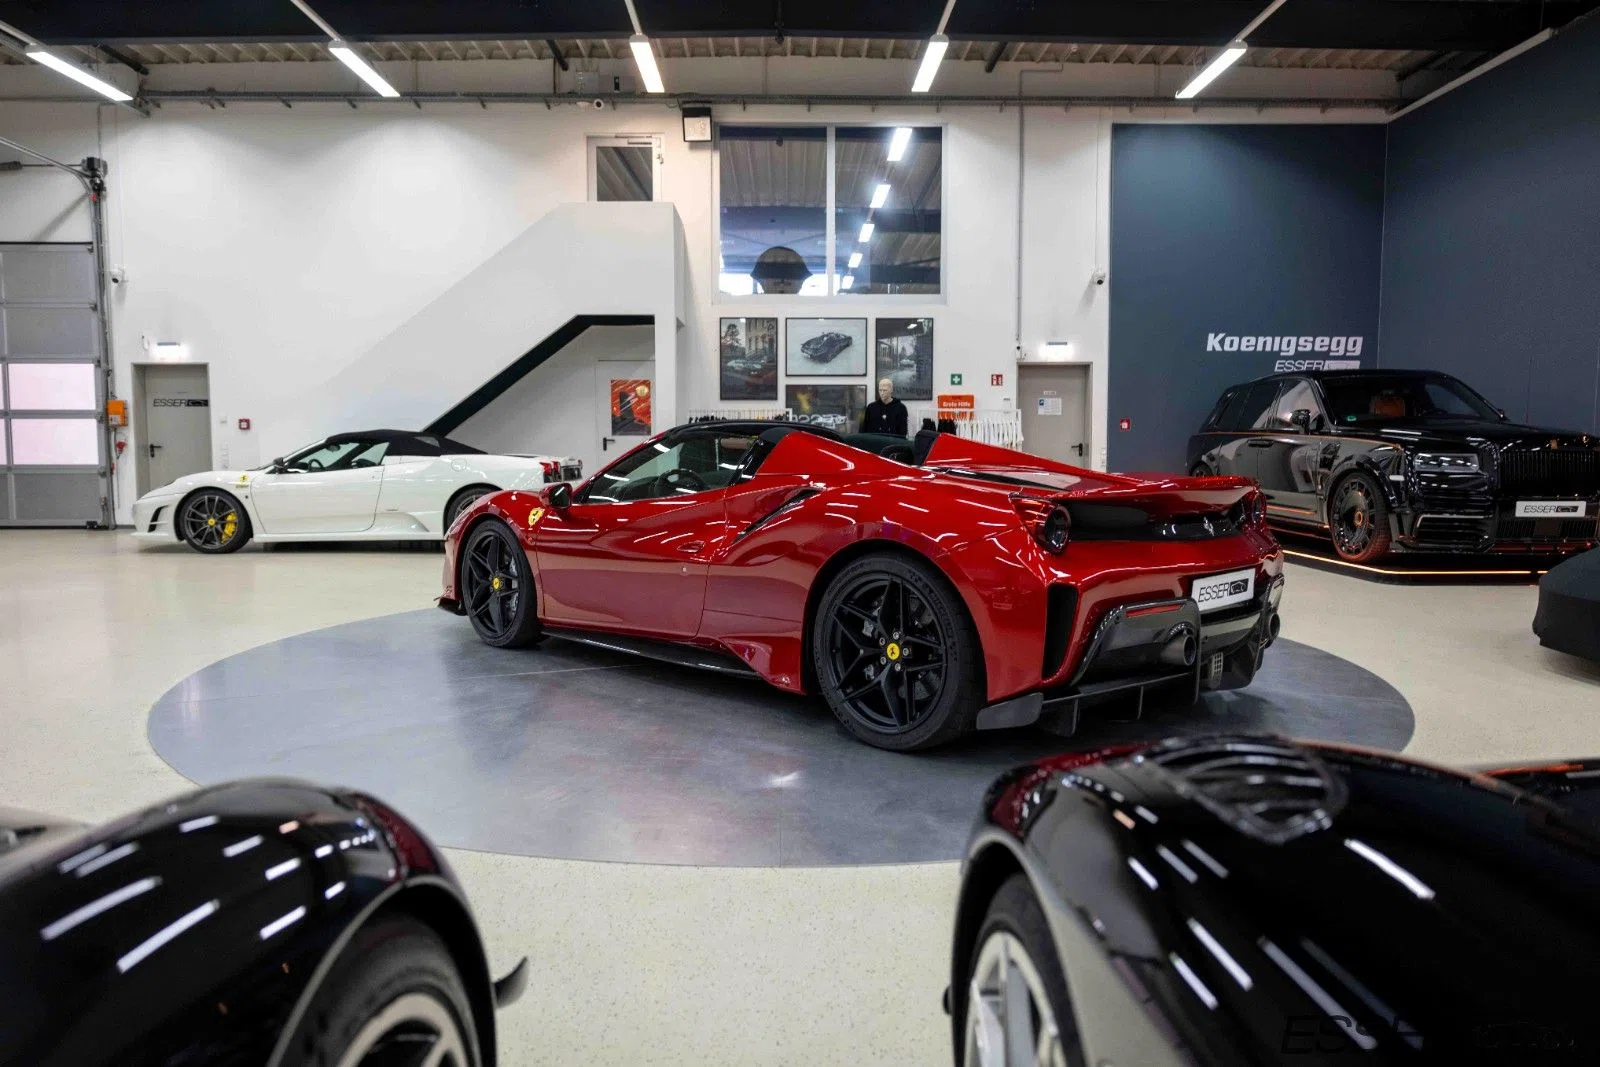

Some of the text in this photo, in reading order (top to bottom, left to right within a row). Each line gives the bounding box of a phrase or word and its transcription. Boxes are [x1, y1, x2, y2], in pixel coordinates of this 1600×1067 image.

[1206, 333, 1363, 356] Koenigsegg
[1274, 360, 1324, 372] ESSER
[153, 398, 187, 407] ESSER
[1523, 504, 1556, 513] ESSER
[1198, 582, 1230, 603] ESSER
